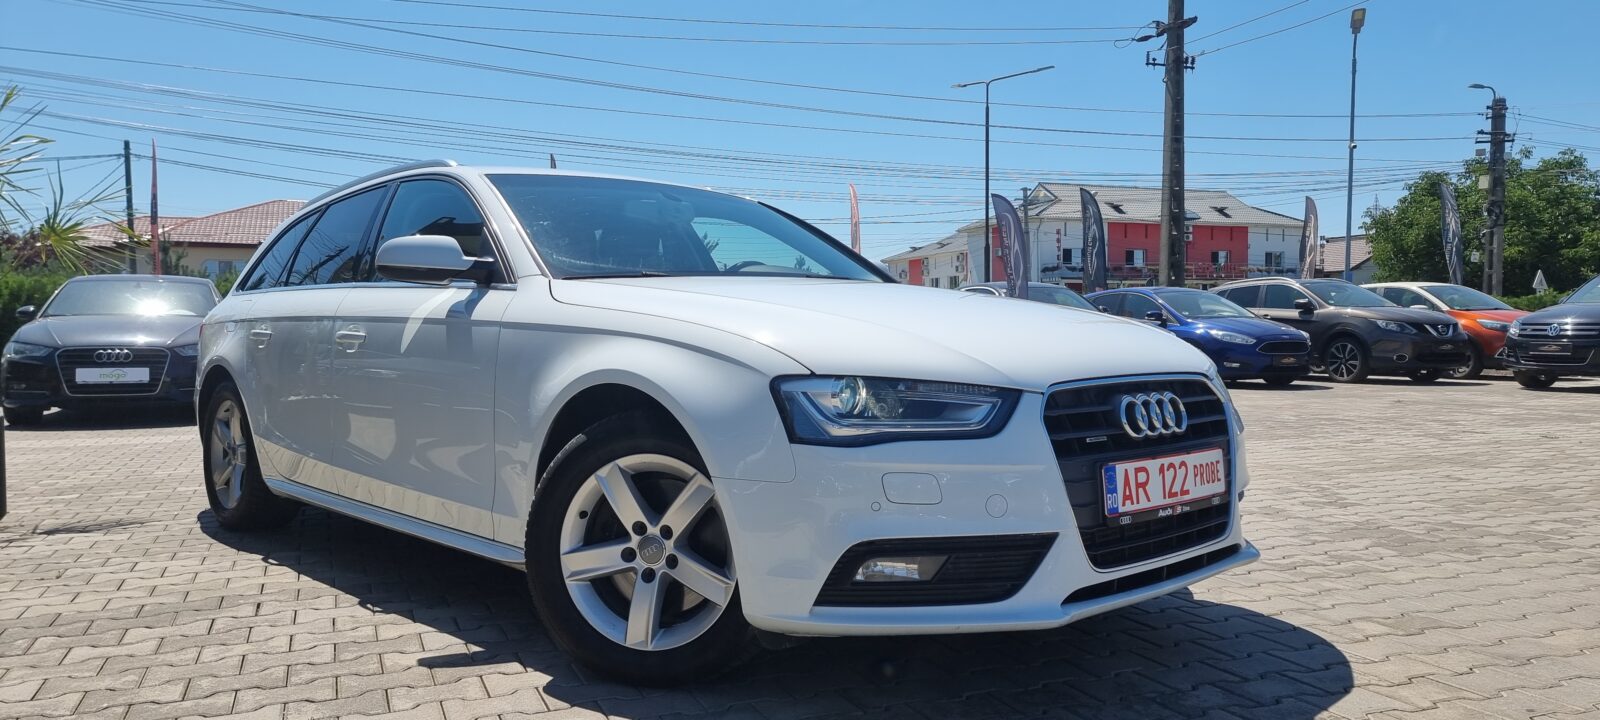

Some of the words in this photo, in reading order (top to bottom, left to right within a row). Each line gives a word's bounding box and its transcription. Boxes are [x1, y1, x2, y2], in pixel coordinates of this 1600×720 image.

[1121, 466, 1151, 507] AR
[1159, 460, 1190, 500] 122
[1193, 460, 1221, 487] PROBE
[1107, 493, 1118, 508] RO
[1158, 507, 1172, 517] Audi
